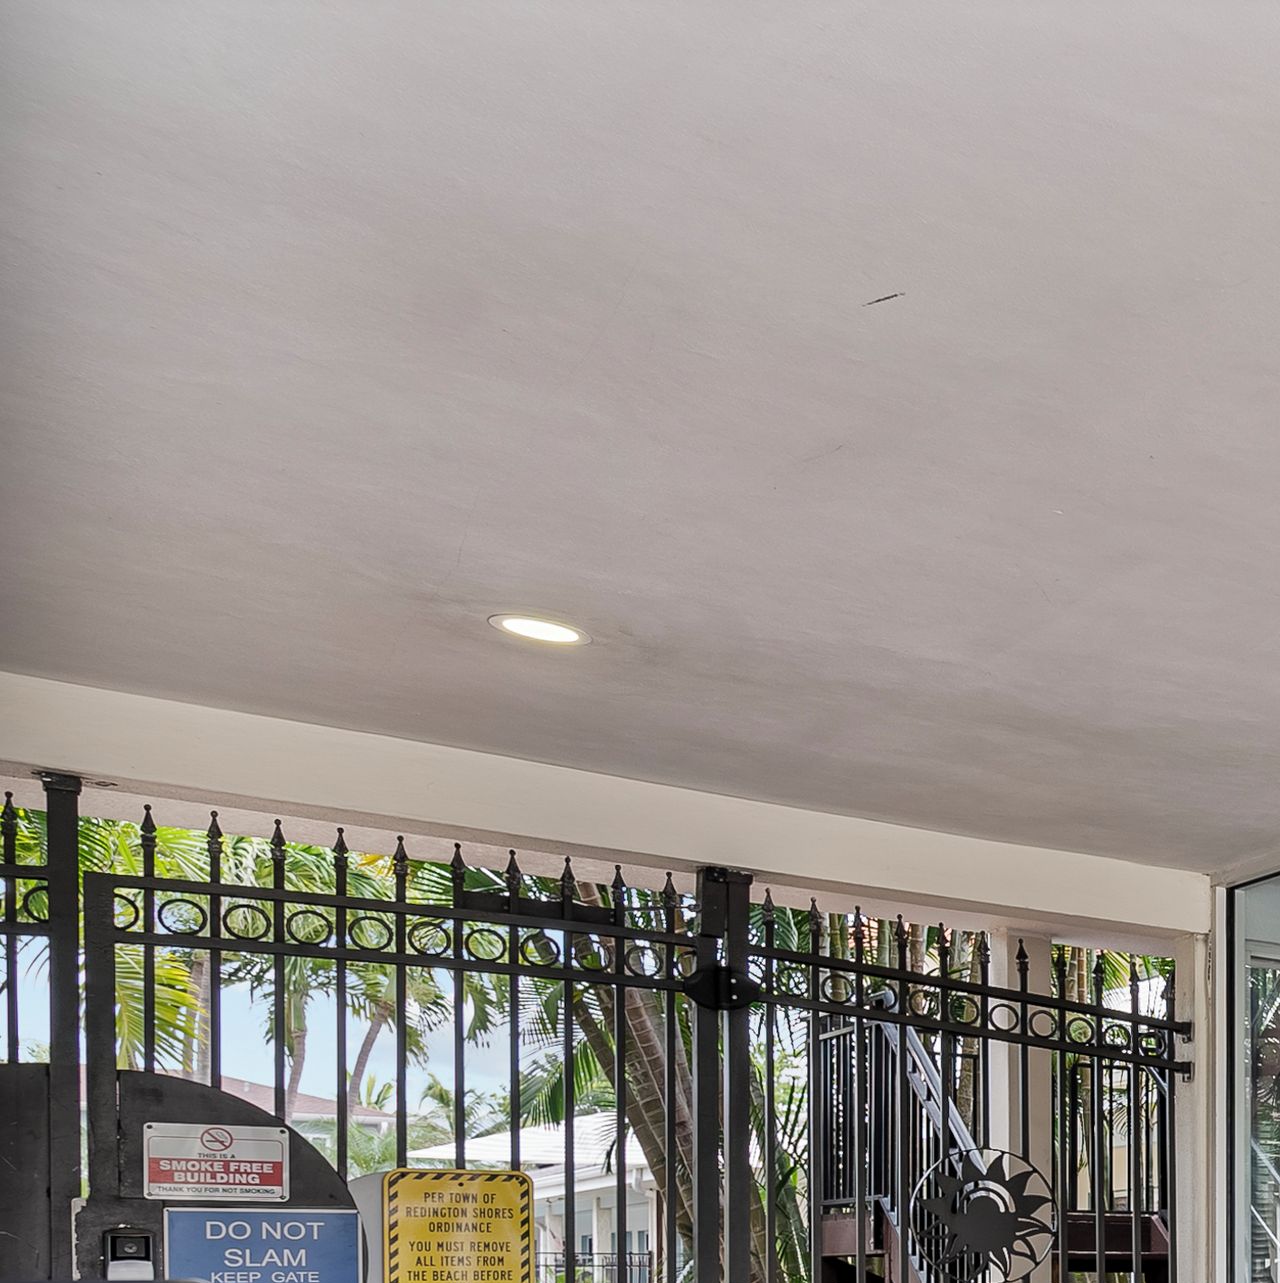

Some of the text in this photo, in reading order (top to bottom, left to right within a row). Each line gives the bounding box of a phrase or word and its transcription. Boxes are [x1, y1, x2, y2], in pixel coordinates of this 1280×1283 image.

[159, 1160, 273, 1173] SMOKE FREE
[173, 1171, 260, 1184] BUILDING
[424, 1192, 497, 1204] PER TOWN OF
[405, 1206, 514, 1219] REDINGTON SHORES
[205, 1221, 325, 1240] DO NOT
[428, 1221, 493, 1233] ORDINANCE
[408, 1241, 512, 1253] YOU MUST REMOVE
[224, 1248, 307, 1267] SLAM
[415, 1256, 505, 1267] ALL ITEMS FROM
[210, 1271, 320, 1283] KEEP GATE
[407, 1270, 513, 1281] THE BEACH BEFORE
